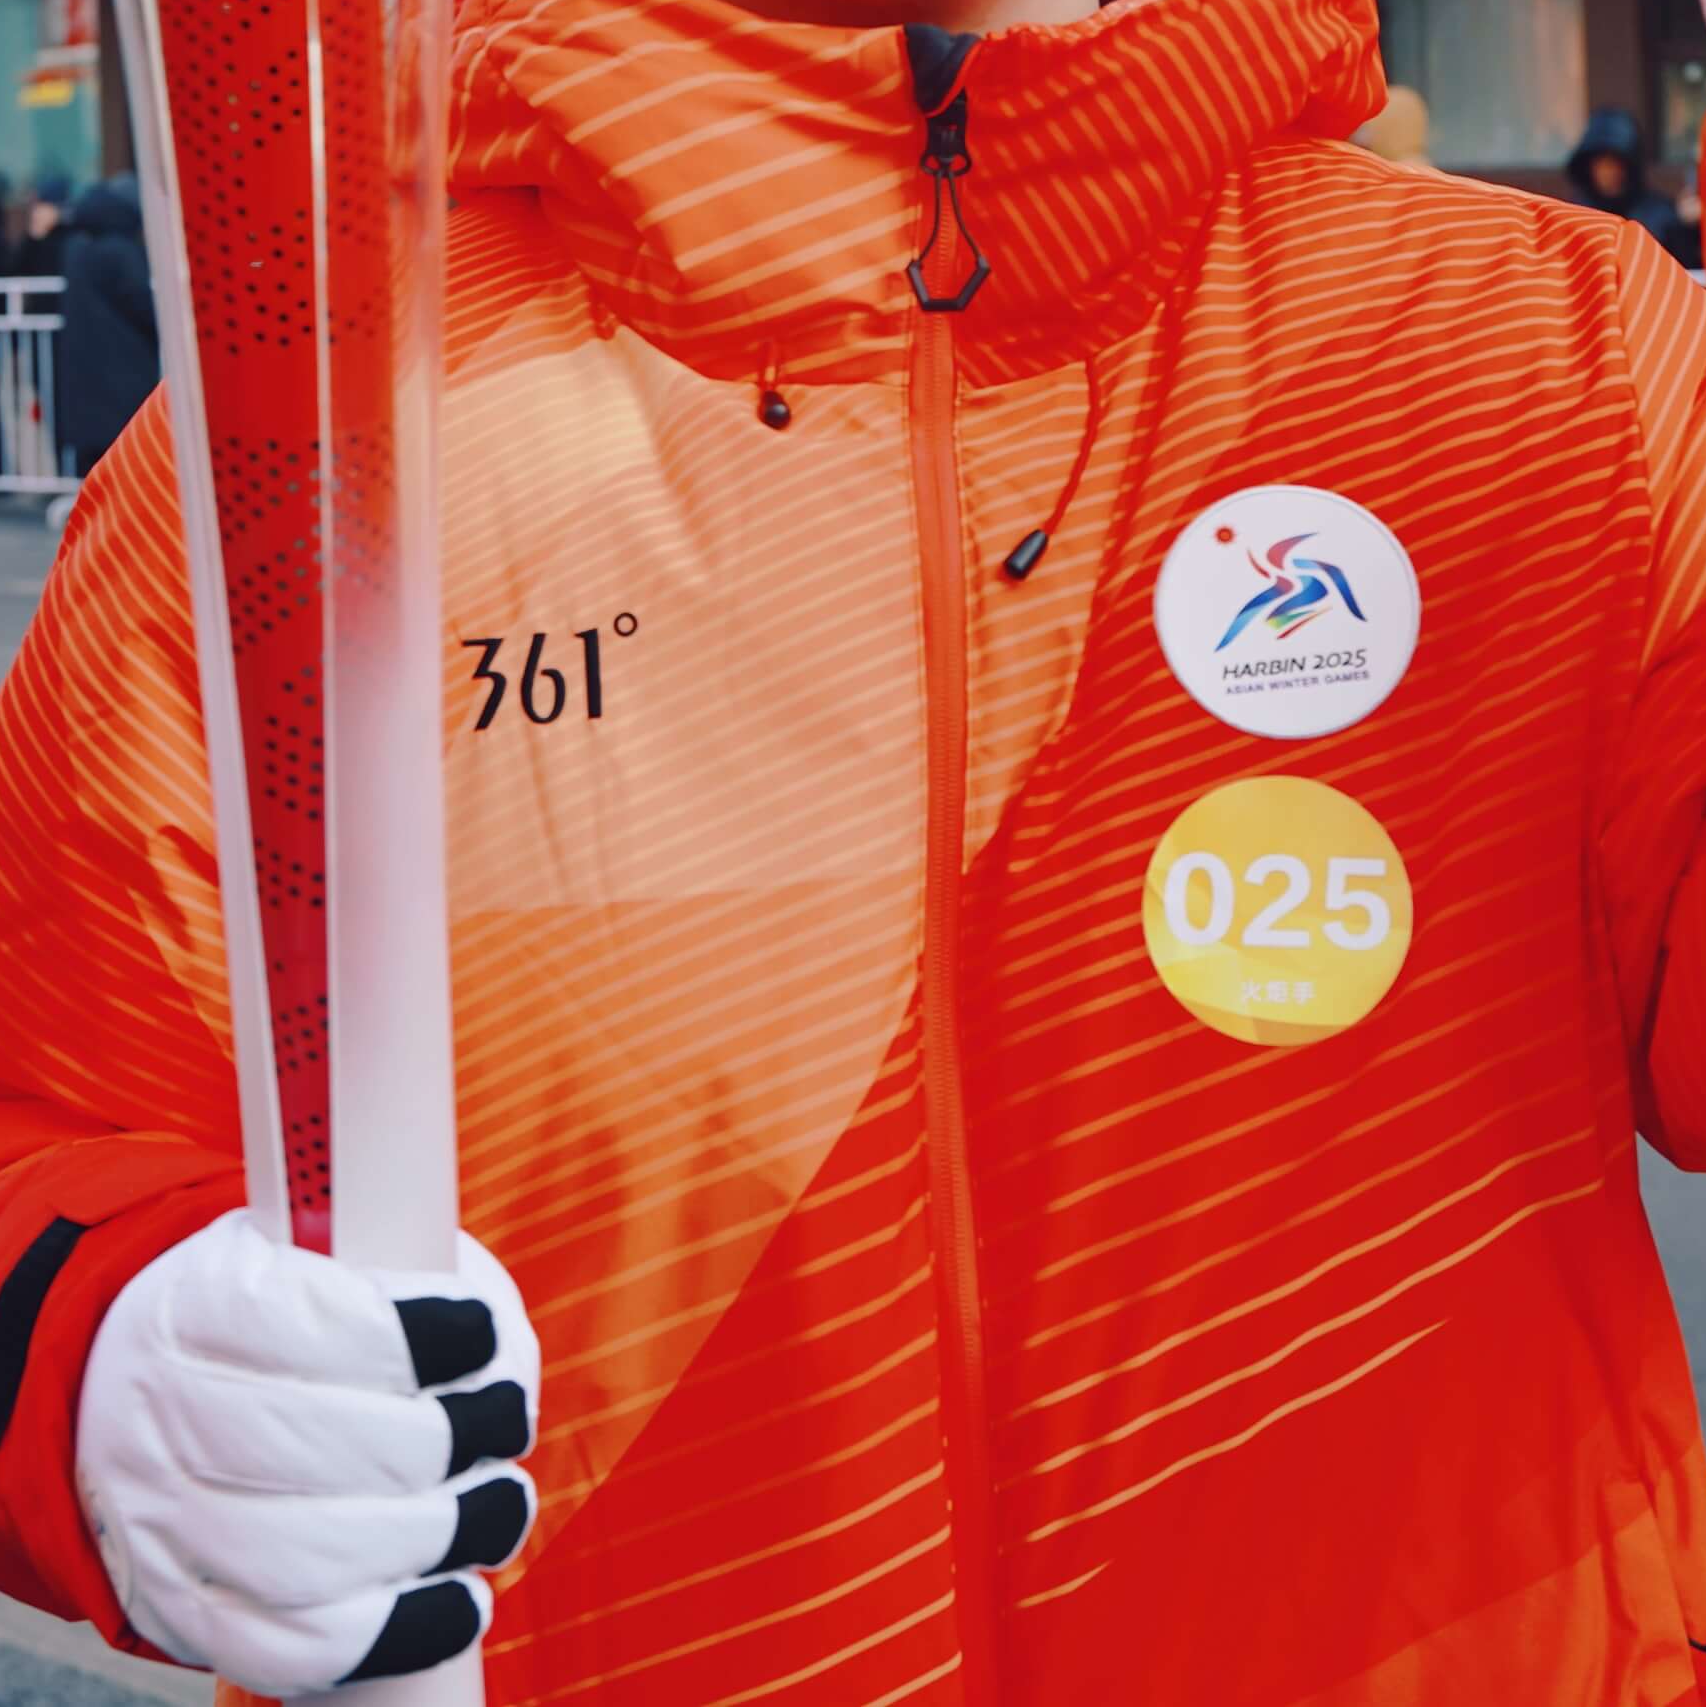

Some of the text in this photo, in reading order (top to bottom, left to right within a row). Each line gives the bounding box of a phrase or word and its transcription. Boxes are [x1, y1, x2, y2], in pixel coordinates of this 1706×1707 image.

[460, 612, 638, 732] 361°
[1223, 648, 1367, 679] HARBIN 2025
[1226, 670, 1370, 694] ASIAN WINTER GAMES
[1163, 850, 1391, 951] 025
